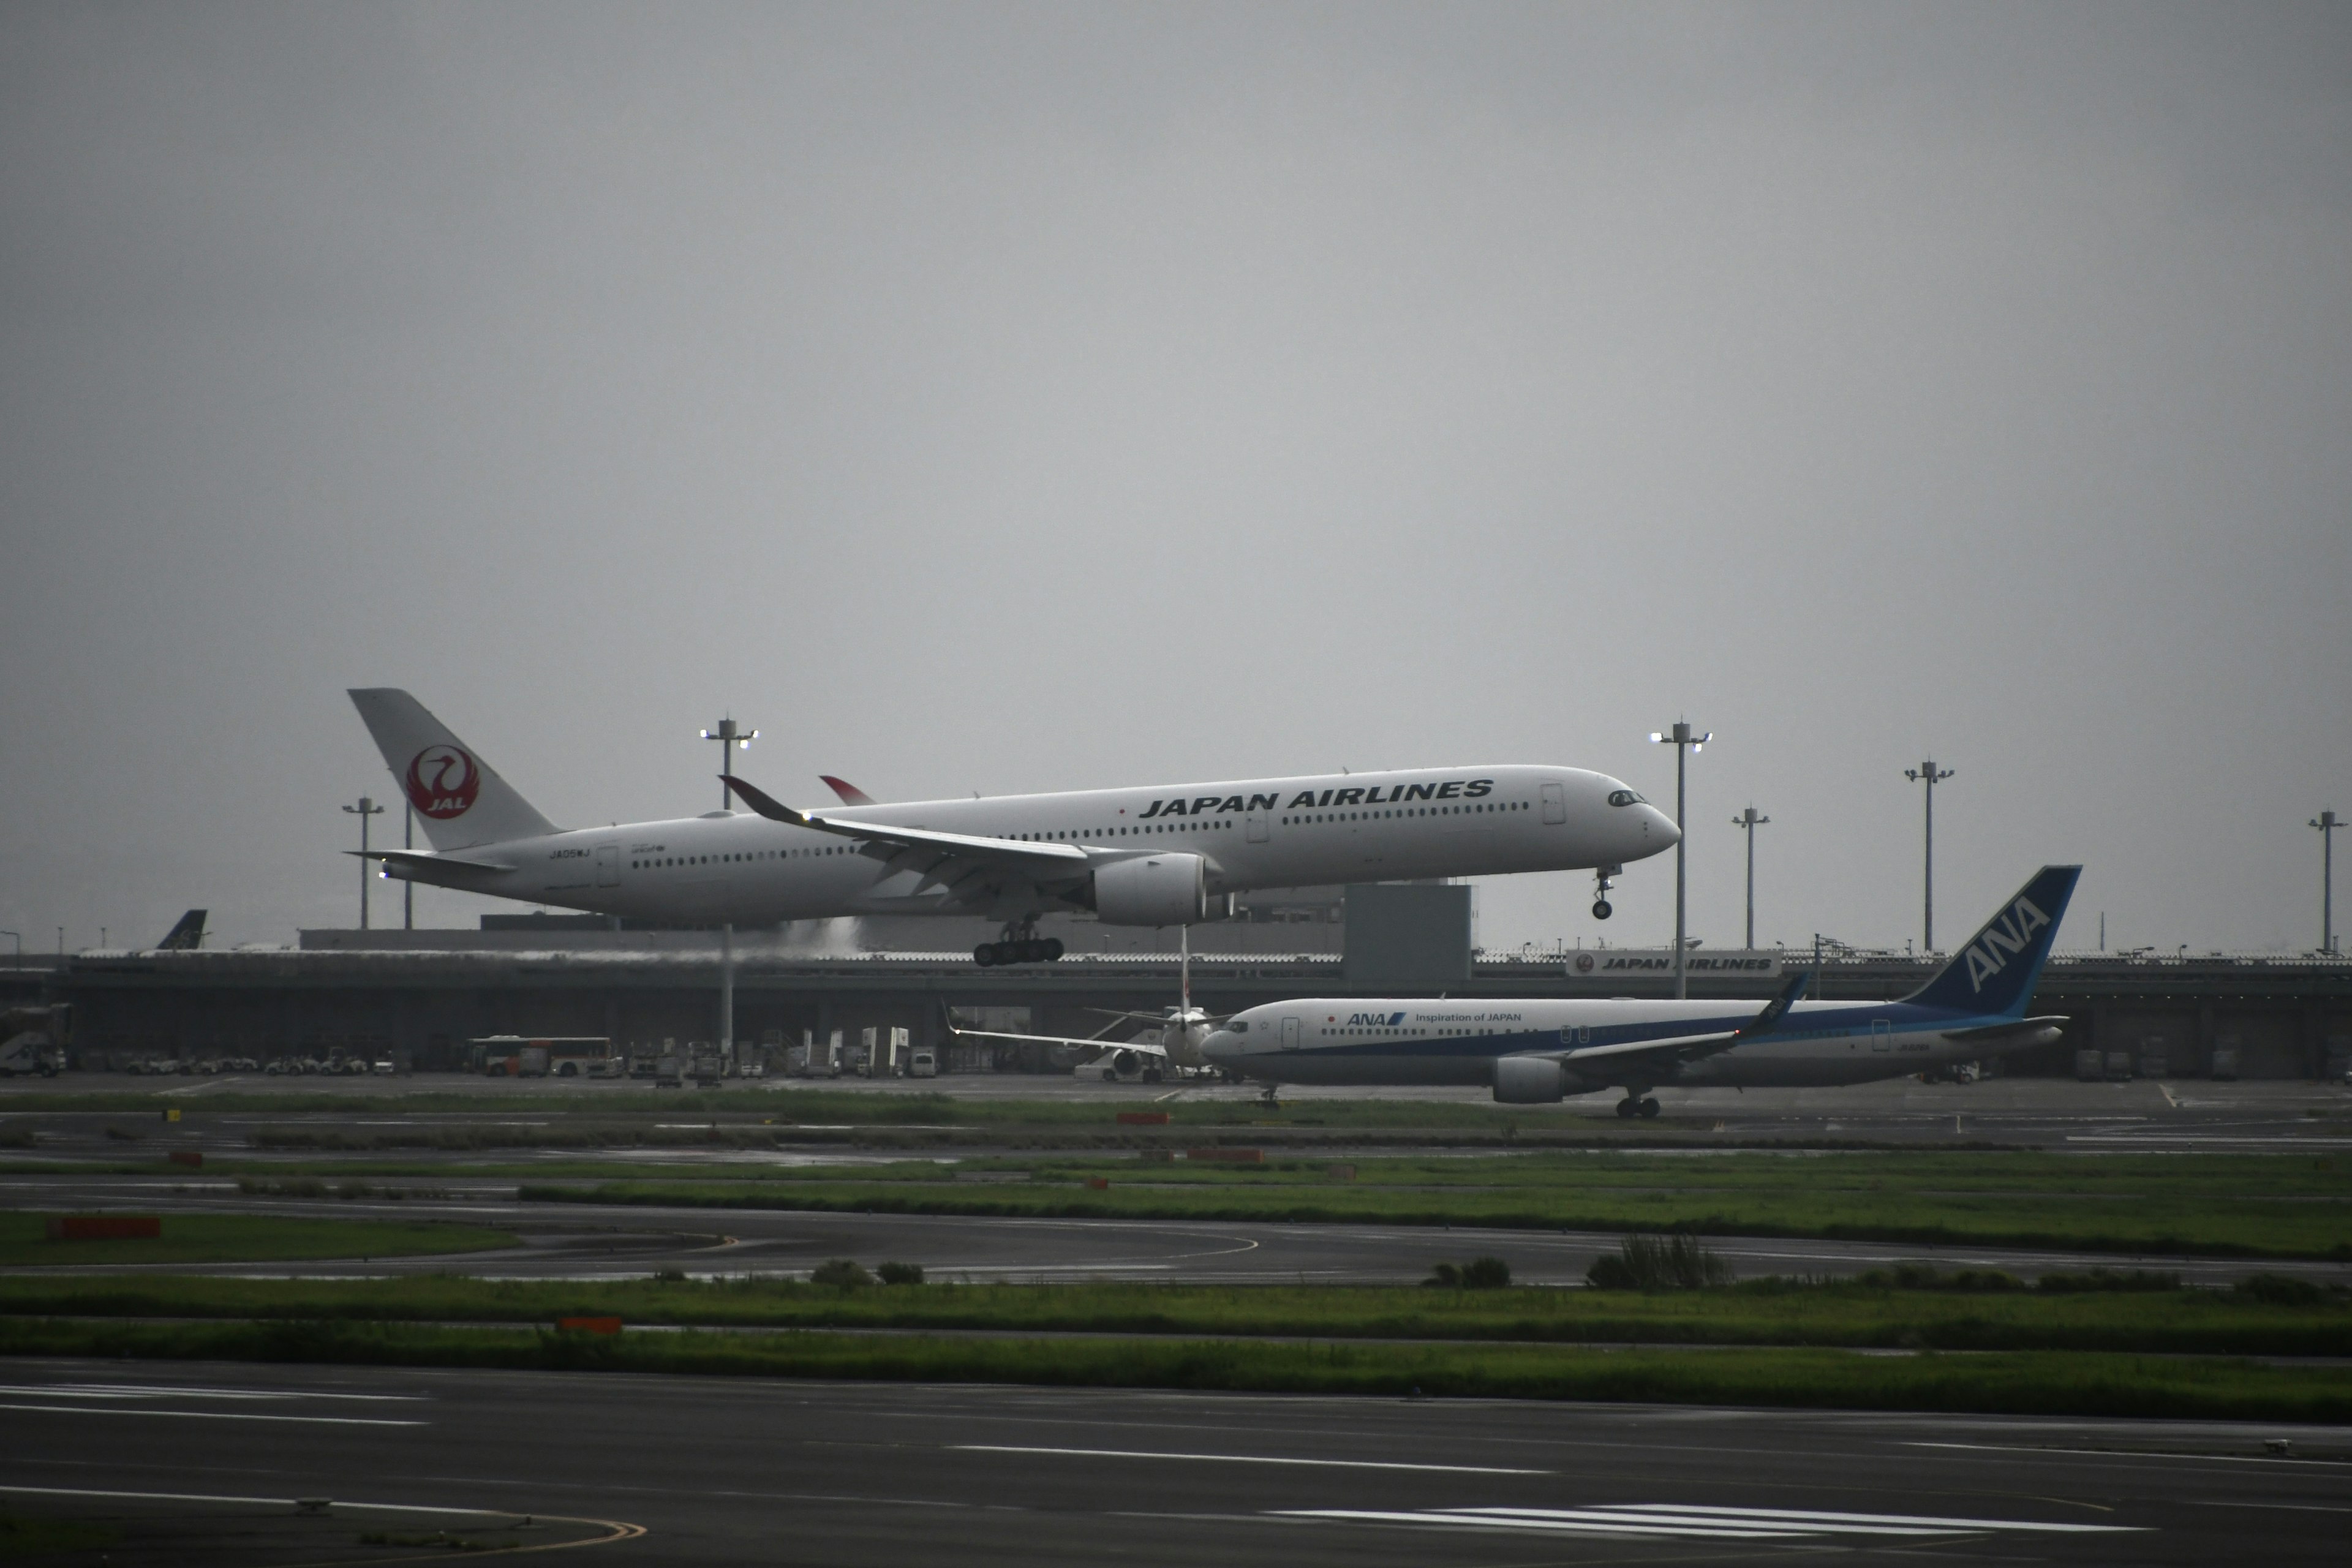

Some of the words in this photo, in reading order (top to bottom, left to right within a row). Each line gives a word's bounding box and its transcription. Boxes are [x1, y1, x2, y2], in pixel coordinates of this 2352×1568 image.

[428, 797, 466, 812] JAL
[1139, 793, 1280, 818] JAPAN
[1287, 779, 1494, 808] AIRLINES
[1965, 895, 2051, 994] ANA
[1602, 958, 1670, 970] JAPAN
[1348, 1013, 1385, 1026] ANA
[1416, 1013, 1471, 1023] Inspiration
[1474, 1012, 1485, 1022] of
